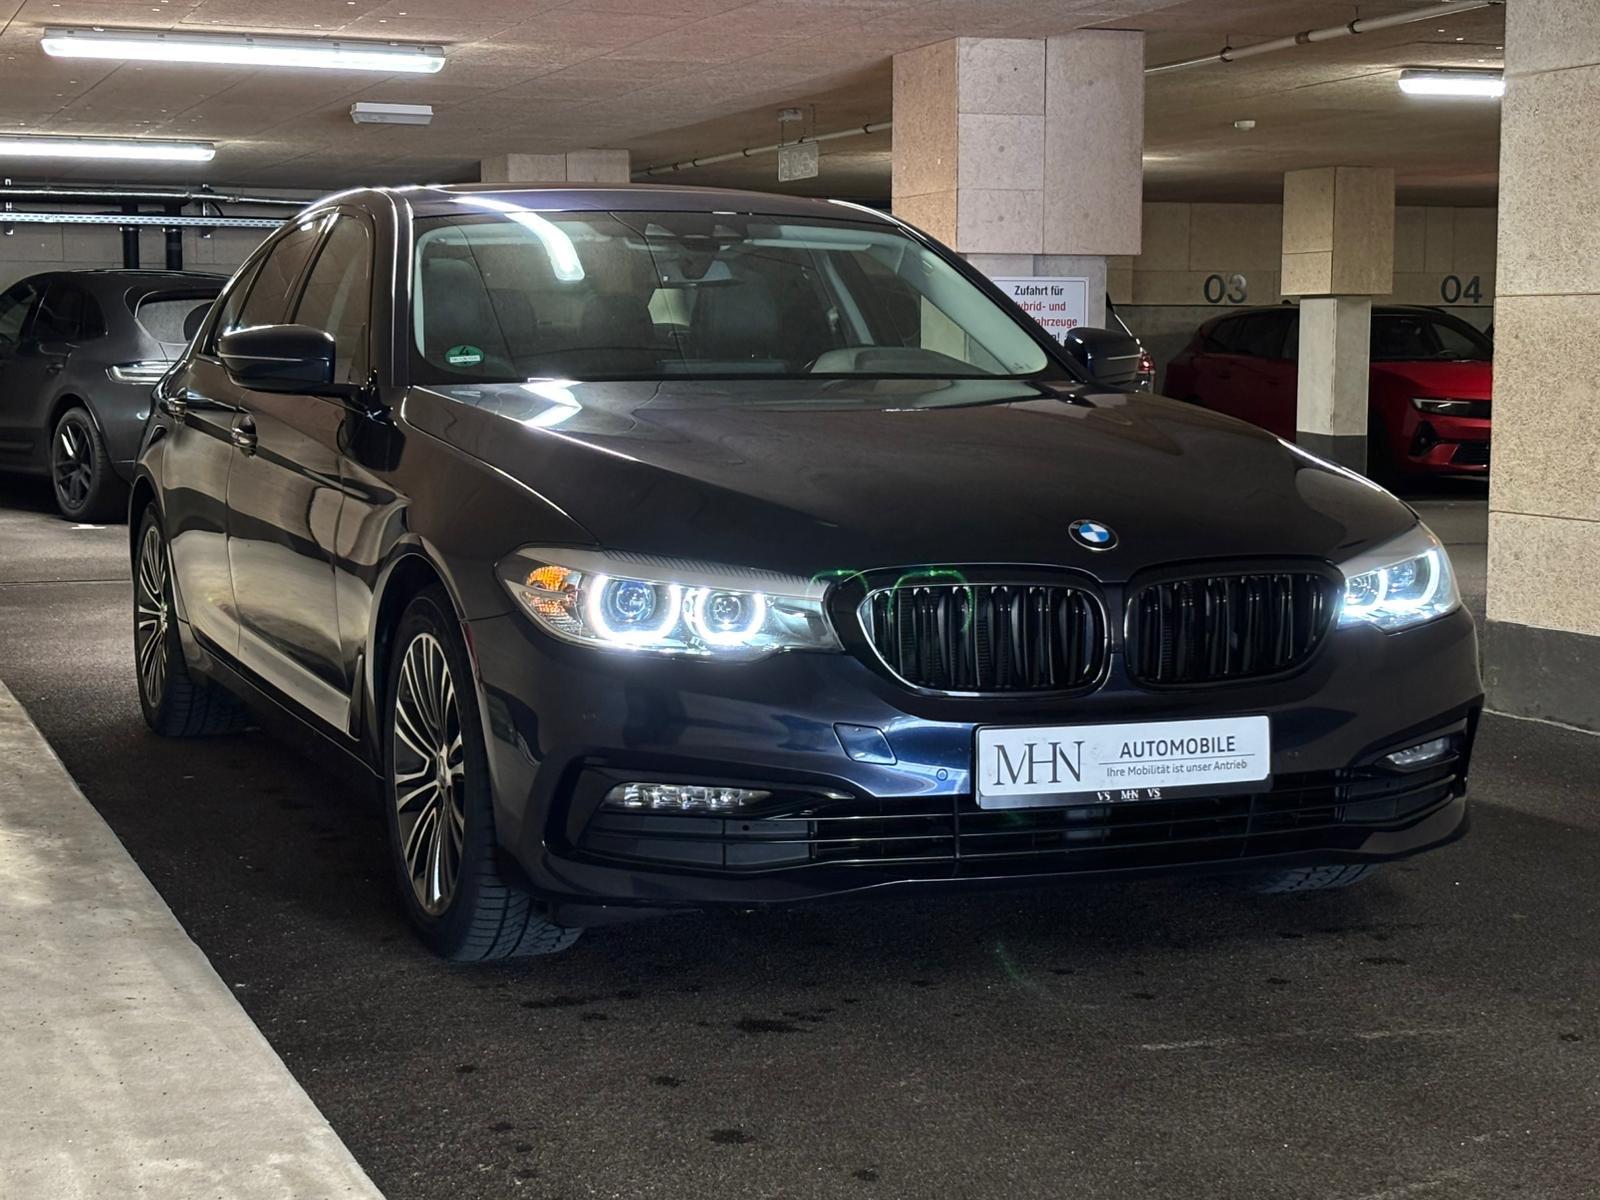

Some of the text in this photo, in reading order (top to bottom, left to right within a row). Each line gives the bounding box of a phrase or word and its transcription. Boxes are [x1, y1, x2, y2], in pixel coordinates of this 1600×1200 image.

[1014, 285, 1064, 296] Zufahrt für
[1203, 274, 1247, 303] 03
[1440, 275, 1483, 303] 04
[1016, 301, 1066, 311] ybrid- und
[1120, 736, 1236, 758] AUTOMOBILE
[993, 741, 1085, 786] MHN
[1106, 759, 1248, 777] Ihre Mobilität ist unser Antrieb
